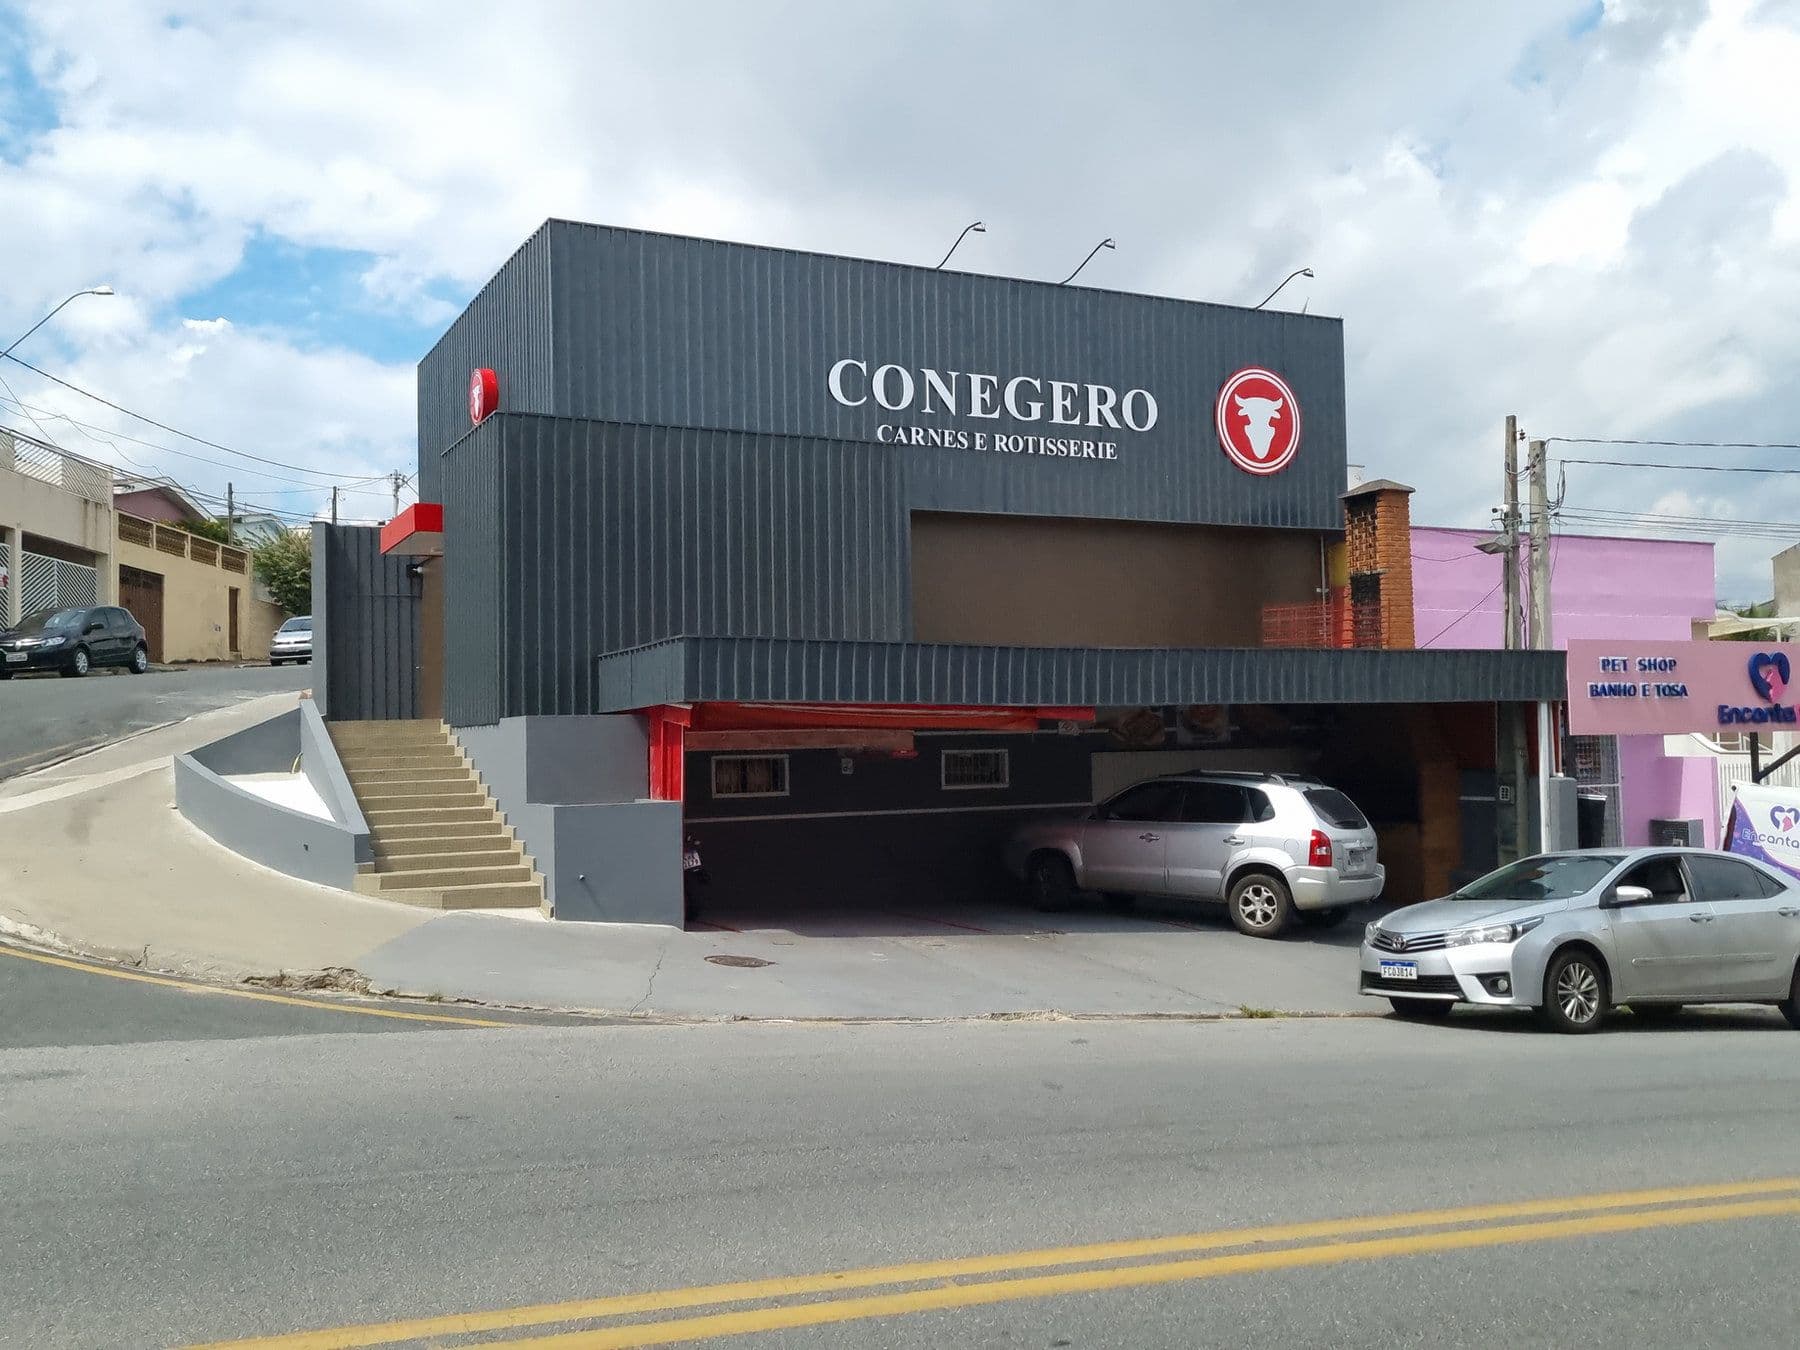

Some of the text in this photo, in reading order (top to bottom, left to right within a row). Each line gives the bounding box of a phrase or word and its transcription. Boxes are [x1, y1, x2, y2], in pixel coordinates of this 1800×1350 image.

[828, 359, 1158, 432] CONEGERO
[876, 424, 1119, 460] CARNES E ROTISSERIE
[1600, 657, 1677, 672] PET SHOP
[1588, 683, 1688, 697] BANHO E TOSA
[1741, 829, 1800, 849] Encanta
